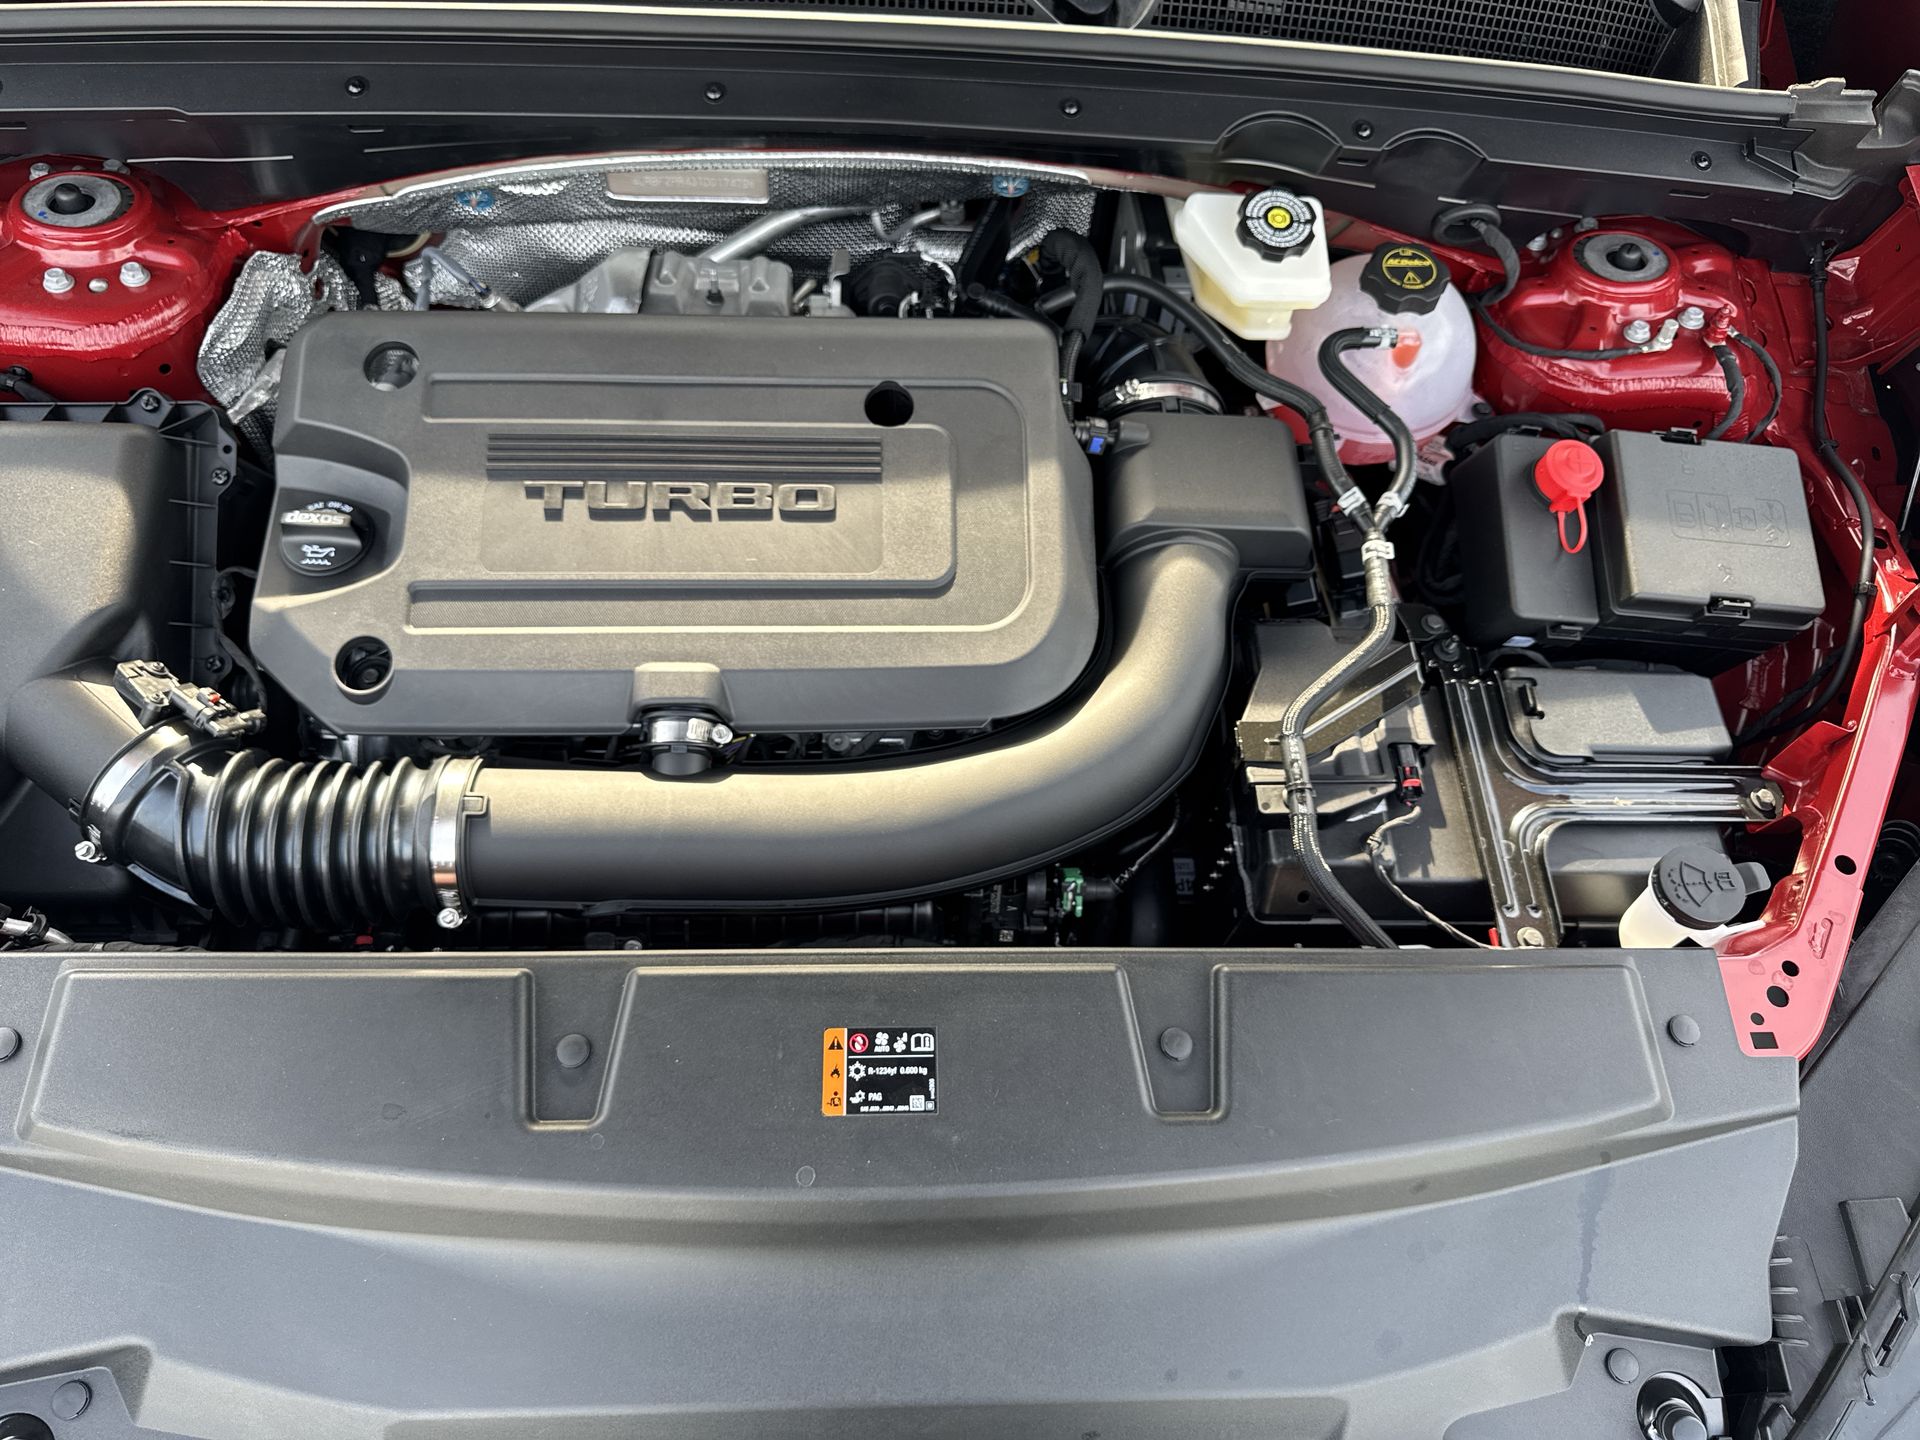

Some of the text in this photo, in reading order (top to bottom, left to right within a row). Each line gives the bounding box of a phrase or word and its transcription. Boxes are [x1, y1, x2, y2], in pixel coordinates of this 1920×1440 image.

[523, 480, 836, 520] TURBO
[285, 510, 344, 525] dexos
[874, 1045, 890, 1053] AUTO
[868, 1067, 897, 1076] R-1234yf
[919, 1066, 928, 1076] kg
[868, 1092, 882, 1101] PAG
